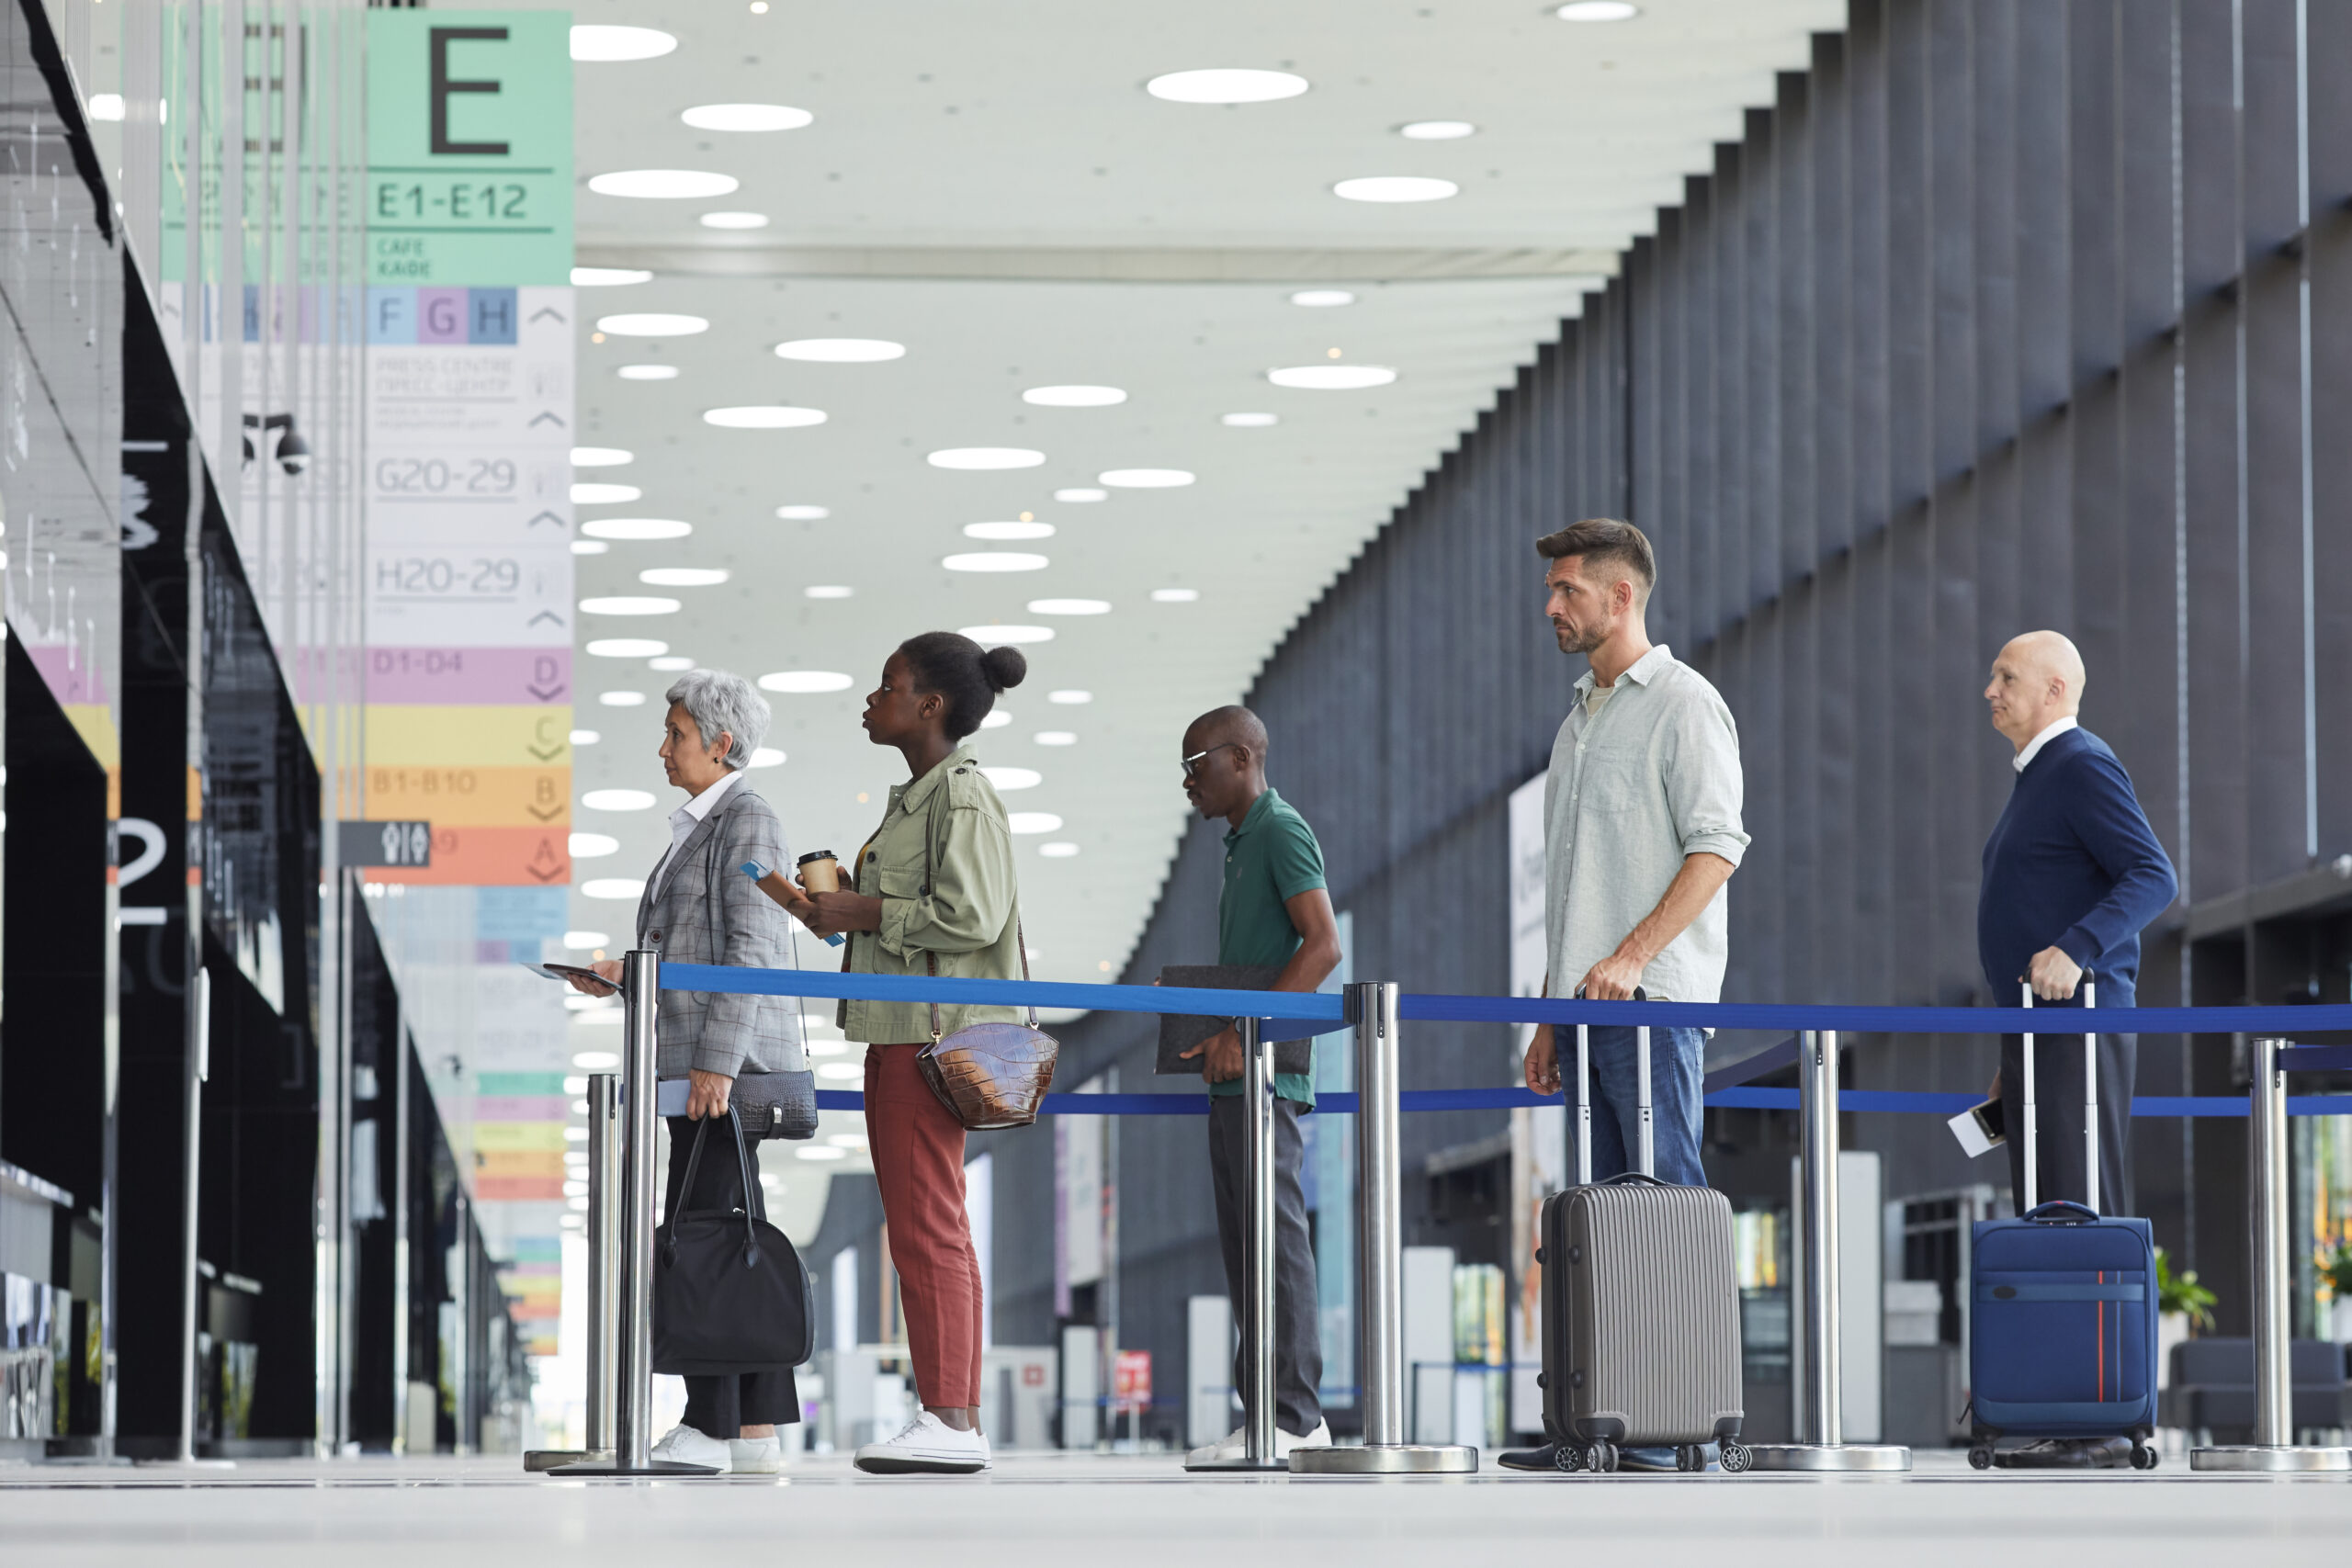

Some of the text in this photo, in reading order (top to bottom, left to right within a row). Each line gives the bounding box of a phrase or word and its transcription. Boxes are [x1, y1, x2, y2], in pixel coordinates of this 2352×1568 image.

[429, 26, 510, 155] E
[377, 184, 526, 219] E1-E12
[377, 239, 424, 255] CAFE
[379, 296, 508, 336] F G H
[375, 457, 517, 493] G20-29
[376, 558, 521, 593] H20-29
[374, 651, 463, 674] D1-D4
[534, 655, 560, 685] D
[536, 716, 556, 745] C
[373, 770, 477, 795] B1-B10
[536, 776, 557, 804] B
[533, 838, 558, 864] A
